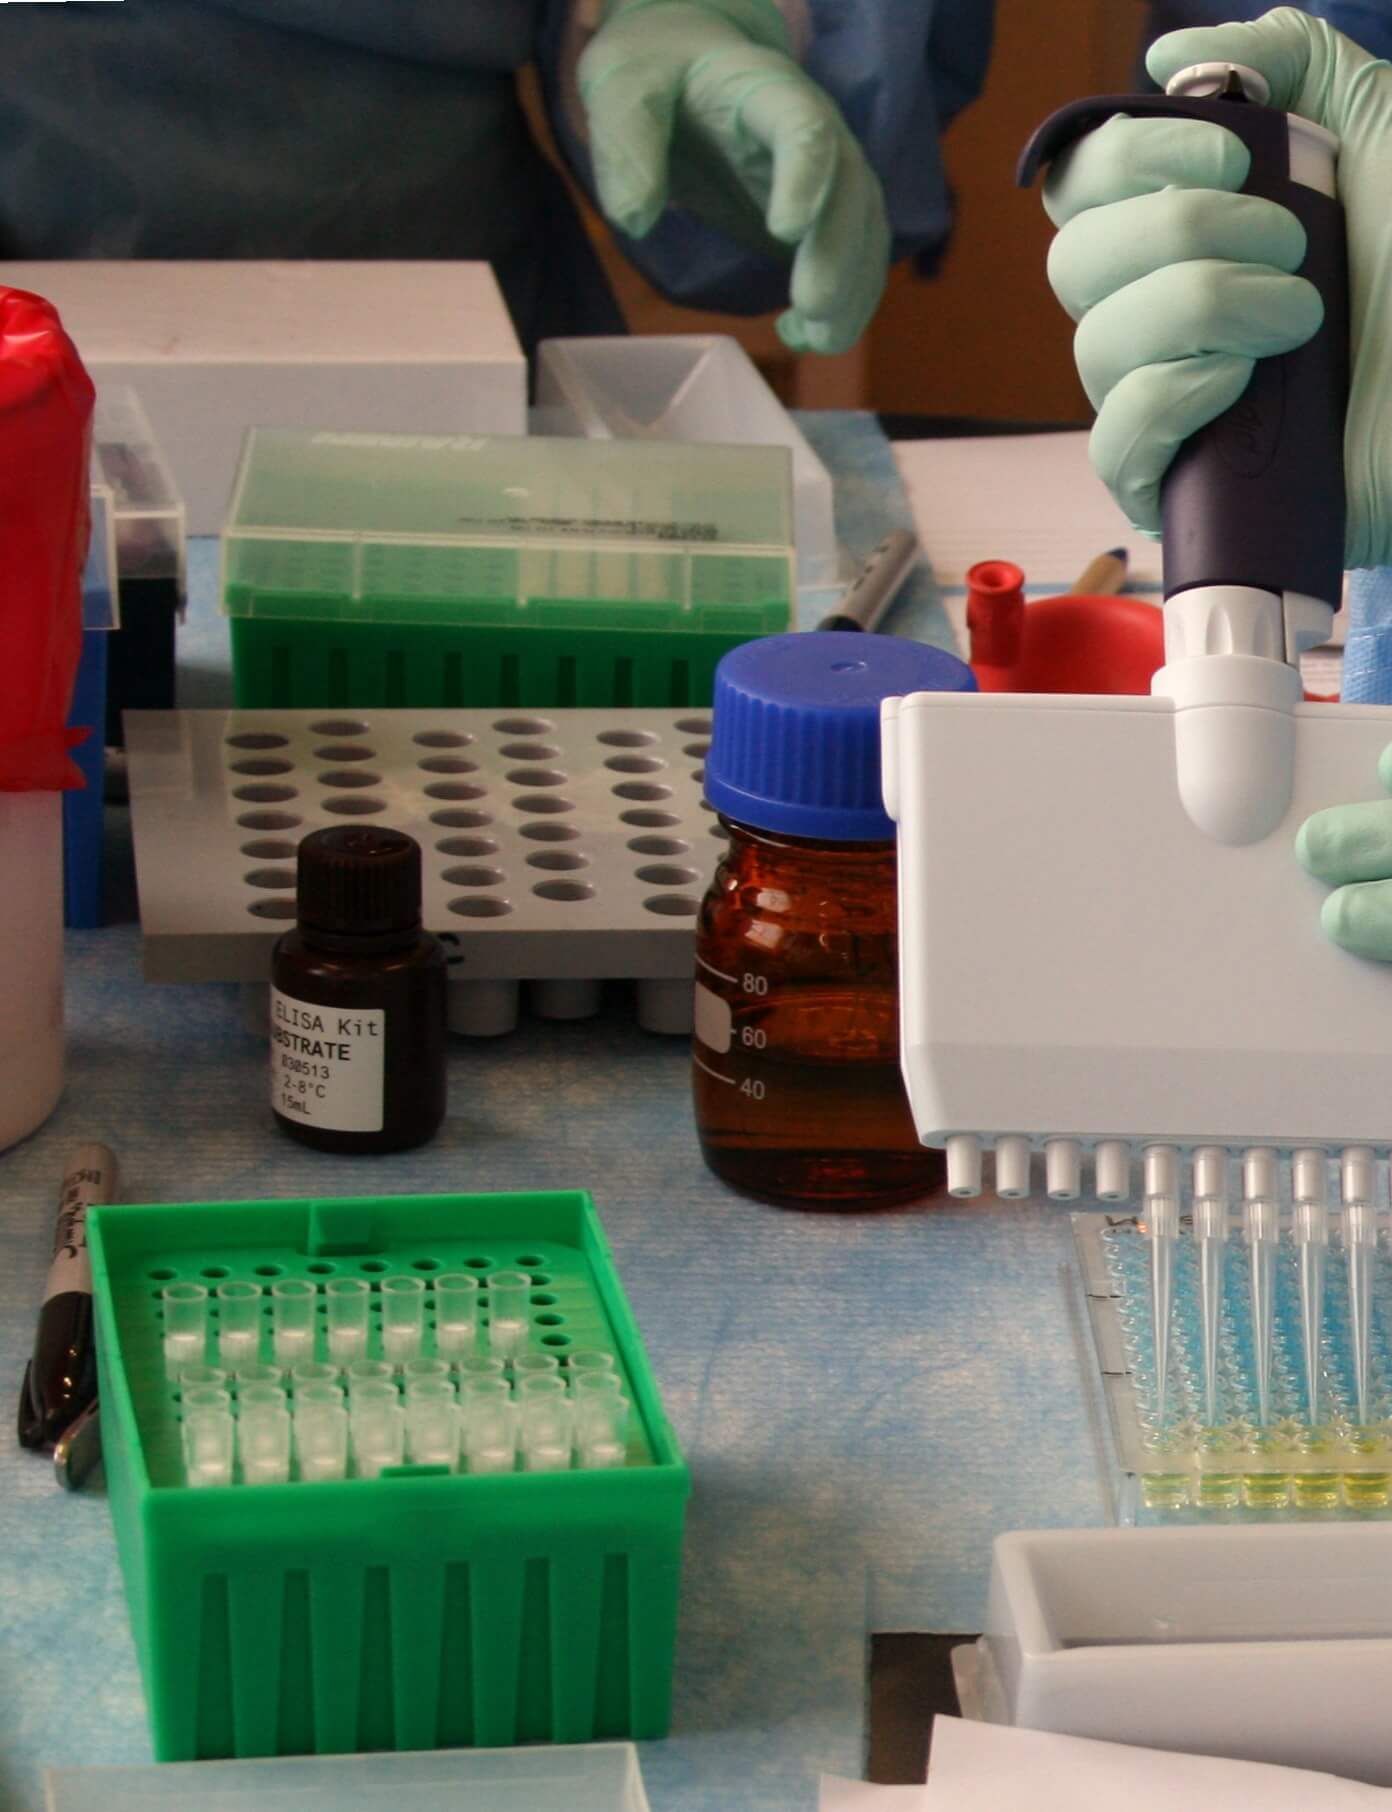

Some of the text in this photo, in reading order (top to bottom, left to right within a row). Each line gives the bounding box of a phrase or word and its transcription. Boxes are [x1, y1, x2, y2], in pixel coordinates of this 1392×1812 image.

[742, 972, 768, 995] 80
[275, 1000, 379, 1037] ELISA Kit
[741, 1025, 767, 1049] 60
[283, 1074, 327, 1098] 2-8°C
[740, 1078, 765, 1101] 40
